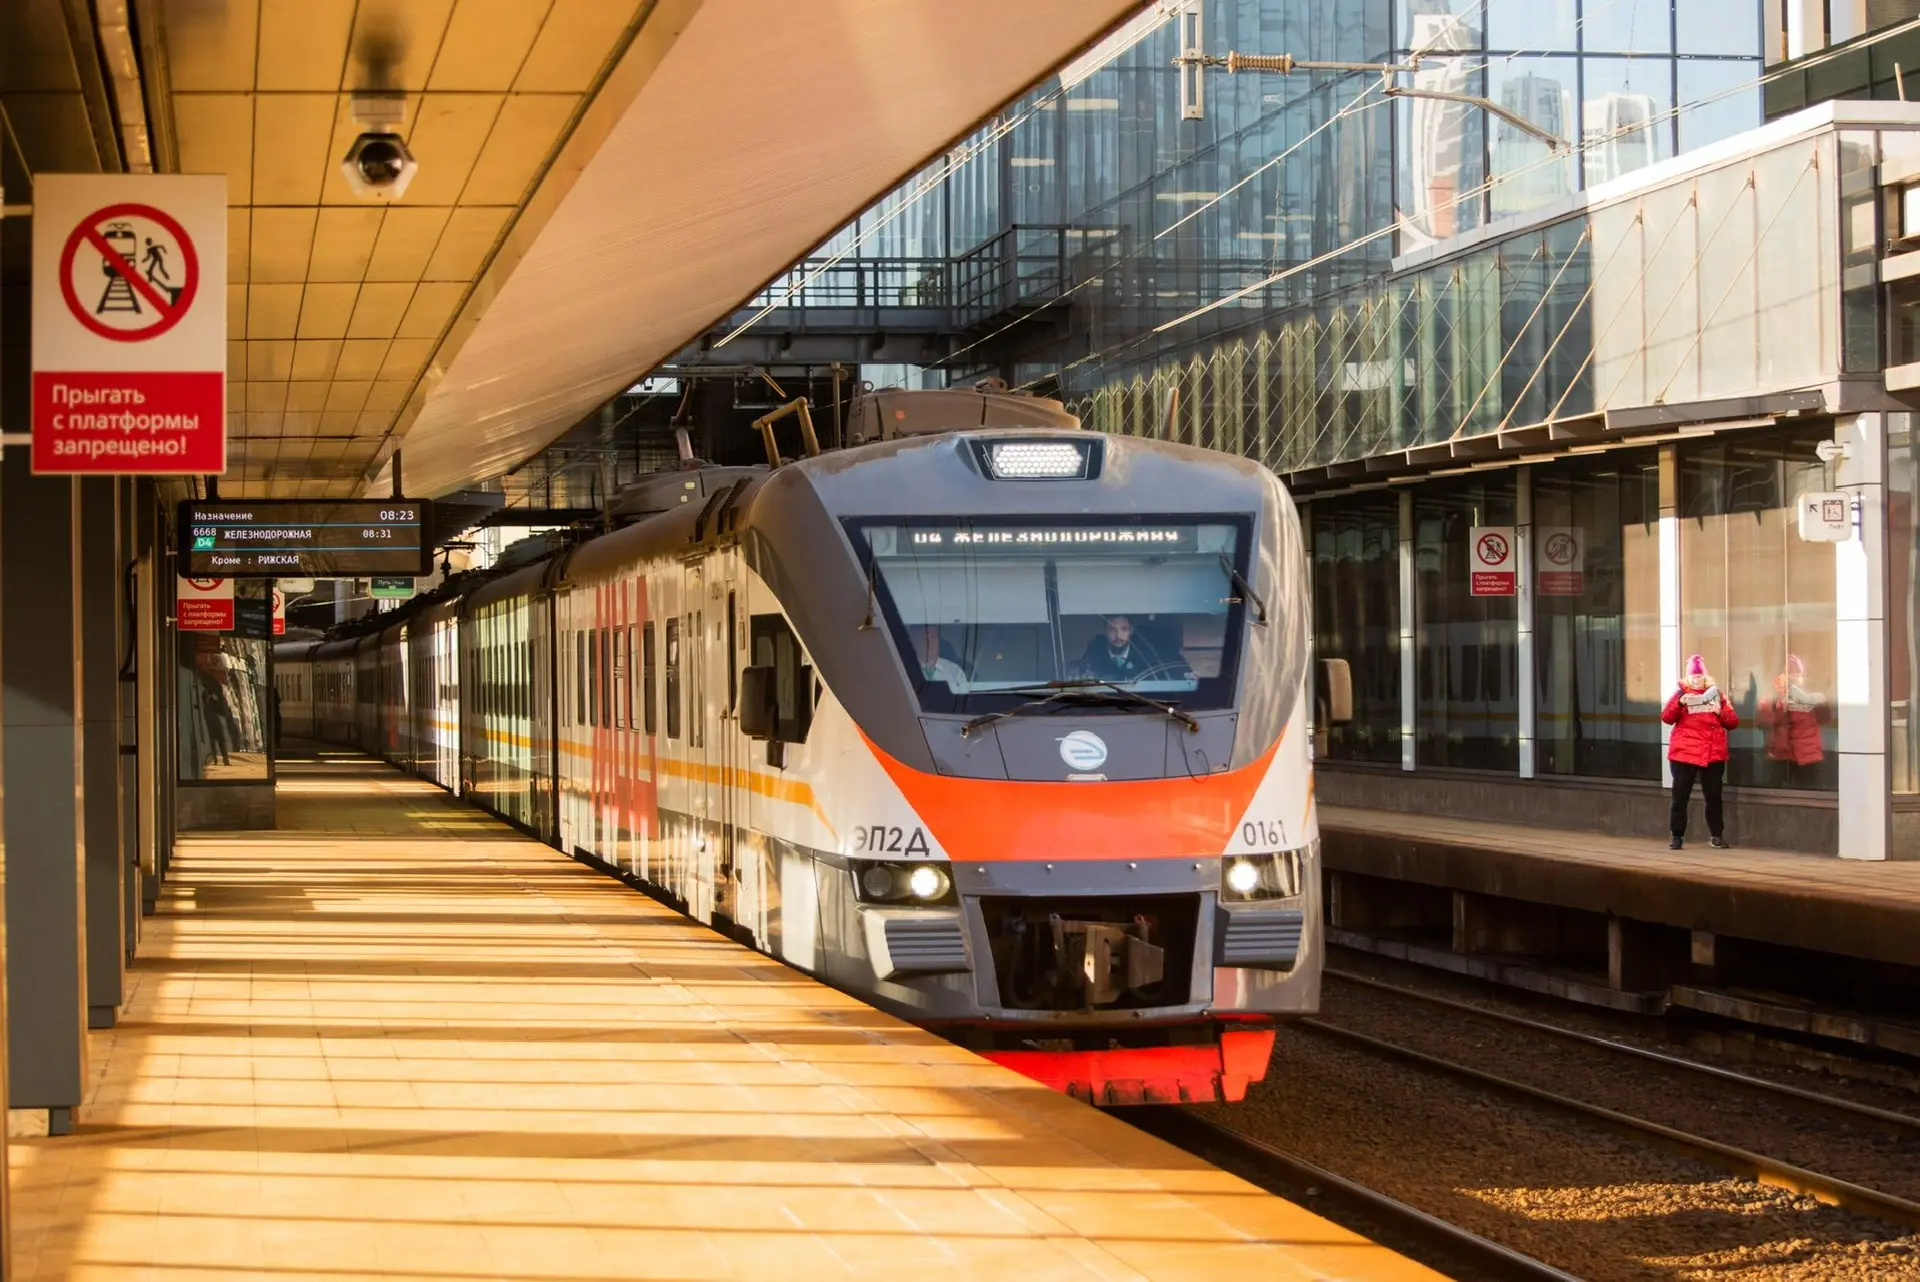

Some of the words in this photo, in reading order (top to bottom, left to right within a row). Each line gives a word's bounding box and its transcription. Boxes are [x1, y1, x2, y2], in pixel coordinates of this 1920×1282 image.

[52, 384, 145, 409] Прыгать
[53, 414, 64, 430] с
[69, 409, 199, 435] платформы
[53, 435, 187, 460] запрещено!
[194, 511, 253, 520] Назначение
[380, 510, 414, 520] 08:23
[193, 527, 217, 536] 6668
[224, 530, 312, 539] ЖЕЛЕЗНОДОРОЖНАЯ
[363, 529, 392, 538] 08:31
[211, 555, 241, 565] Кроме
[258, 555, 299, 564] РИЖСКАЯ
[183, 602, 211, 610] Прыгать
[188, 610, 227, 618] платформы
[183, 618, 223, 626] запрещено!
[1243, 820, 1287, 847] 0161
[853, 825, 931, 858] ЭП2Д
